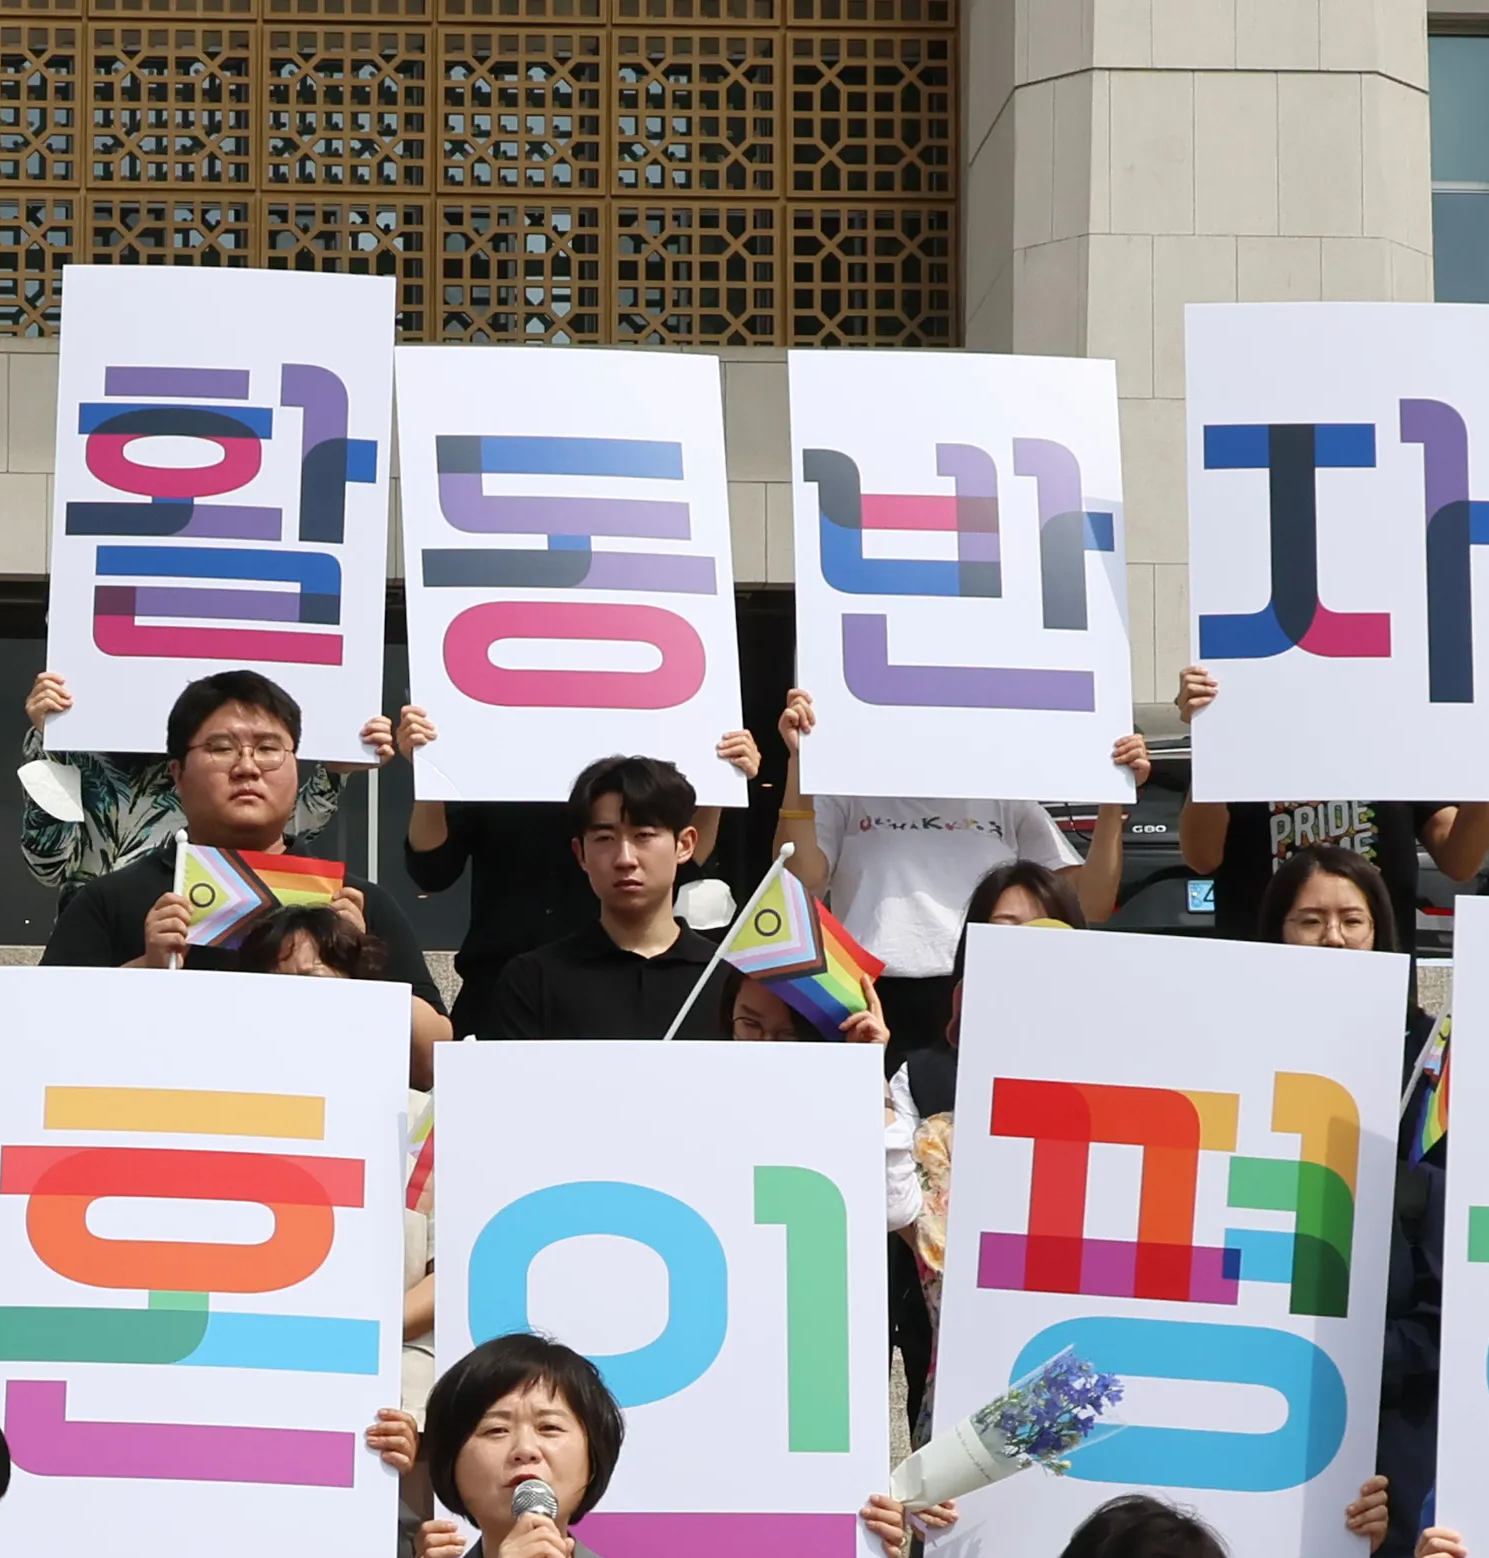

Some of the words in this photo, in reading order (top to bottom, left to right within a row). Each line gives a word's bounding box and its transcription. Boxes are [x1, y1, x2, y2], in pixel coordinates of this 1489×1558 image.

[65, 363, 378, 666] 활
[422, 435, 716, 709] 동
[802, 437, 1115, 713] 반
[1132, 824, 1167, 833] G80
[1270, 800, 1373, 855] PRIDE
[977, 1071, 1360, 1492] 평
